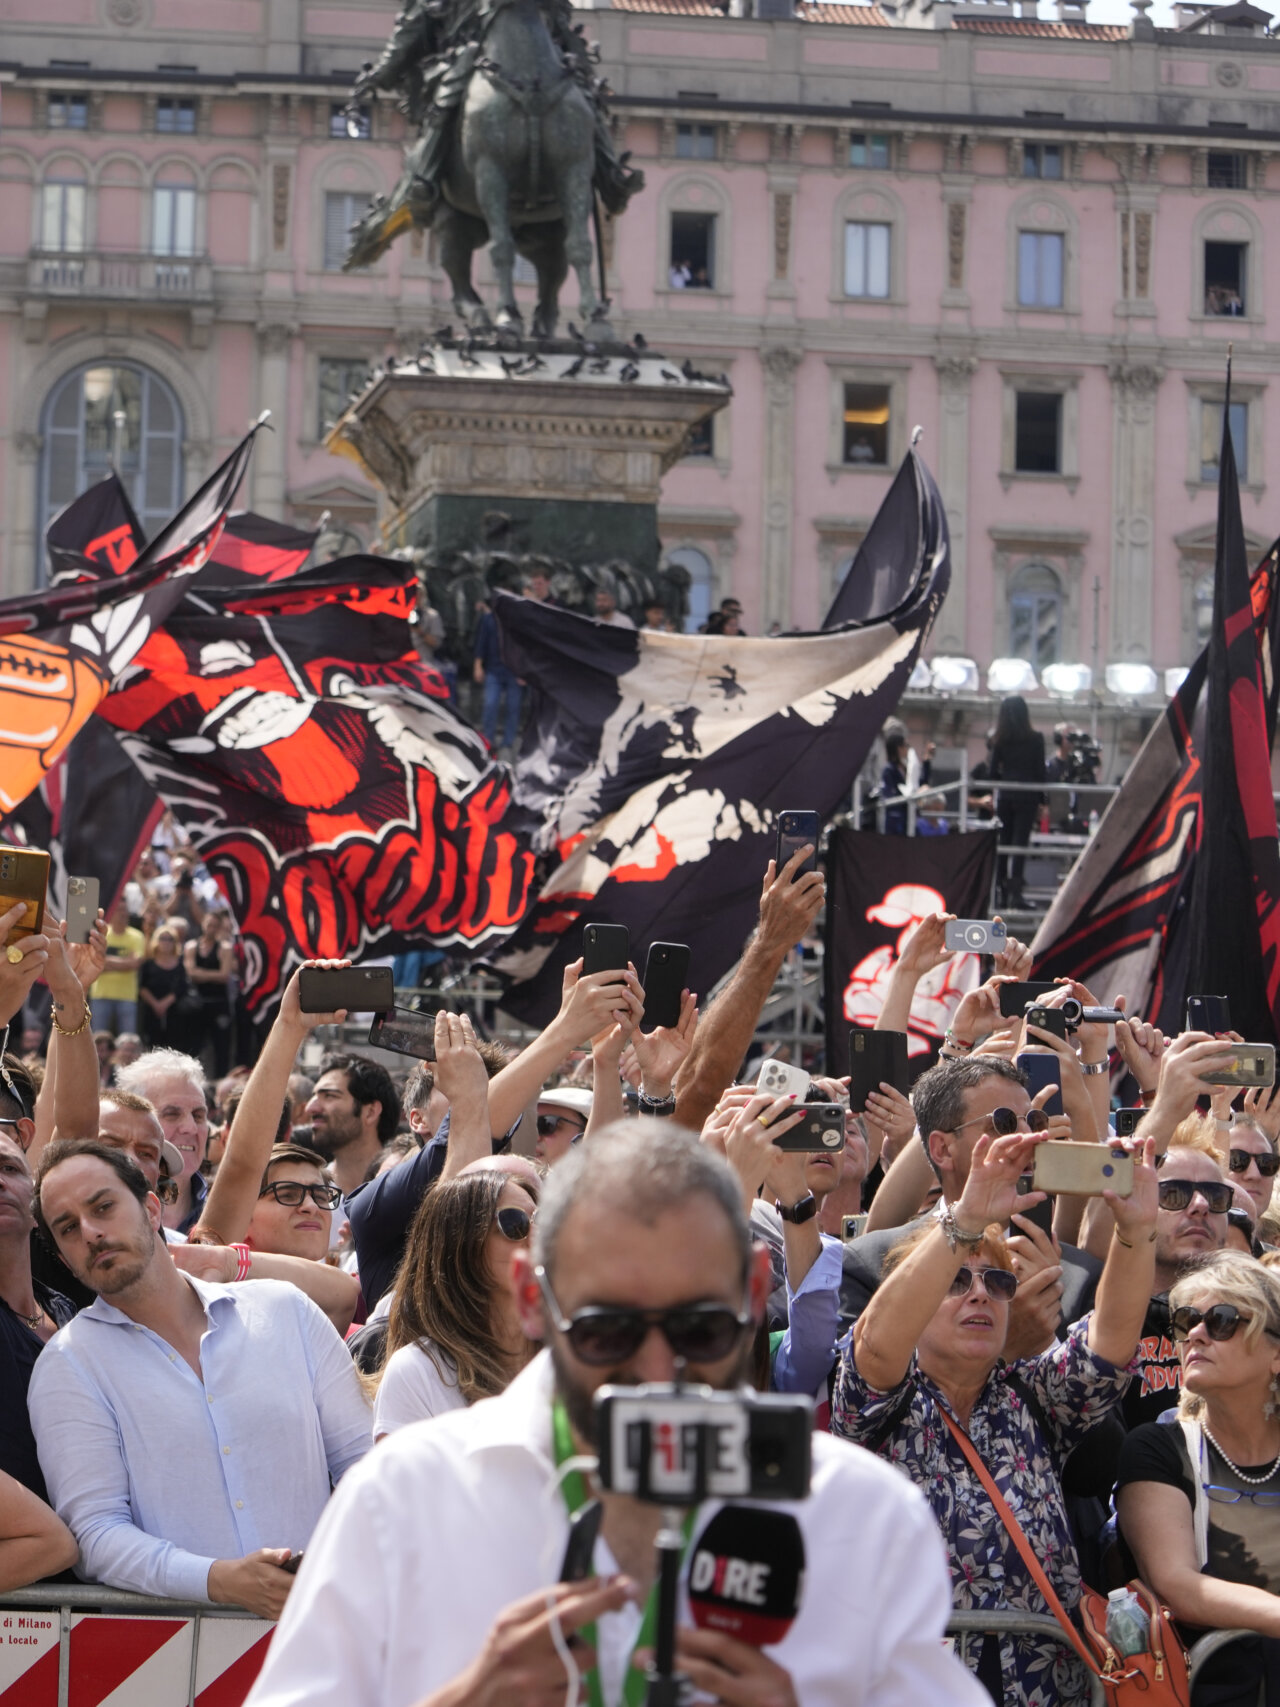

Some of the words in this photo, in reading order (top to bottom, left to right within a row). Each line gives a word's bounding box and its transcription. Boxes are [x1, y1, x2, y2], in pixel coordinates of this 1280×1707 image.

[3, 1617, 13, 1628] di
[18, 1617, 52, 1629] Milano
[8, 1634, 38, 1645] Locale
